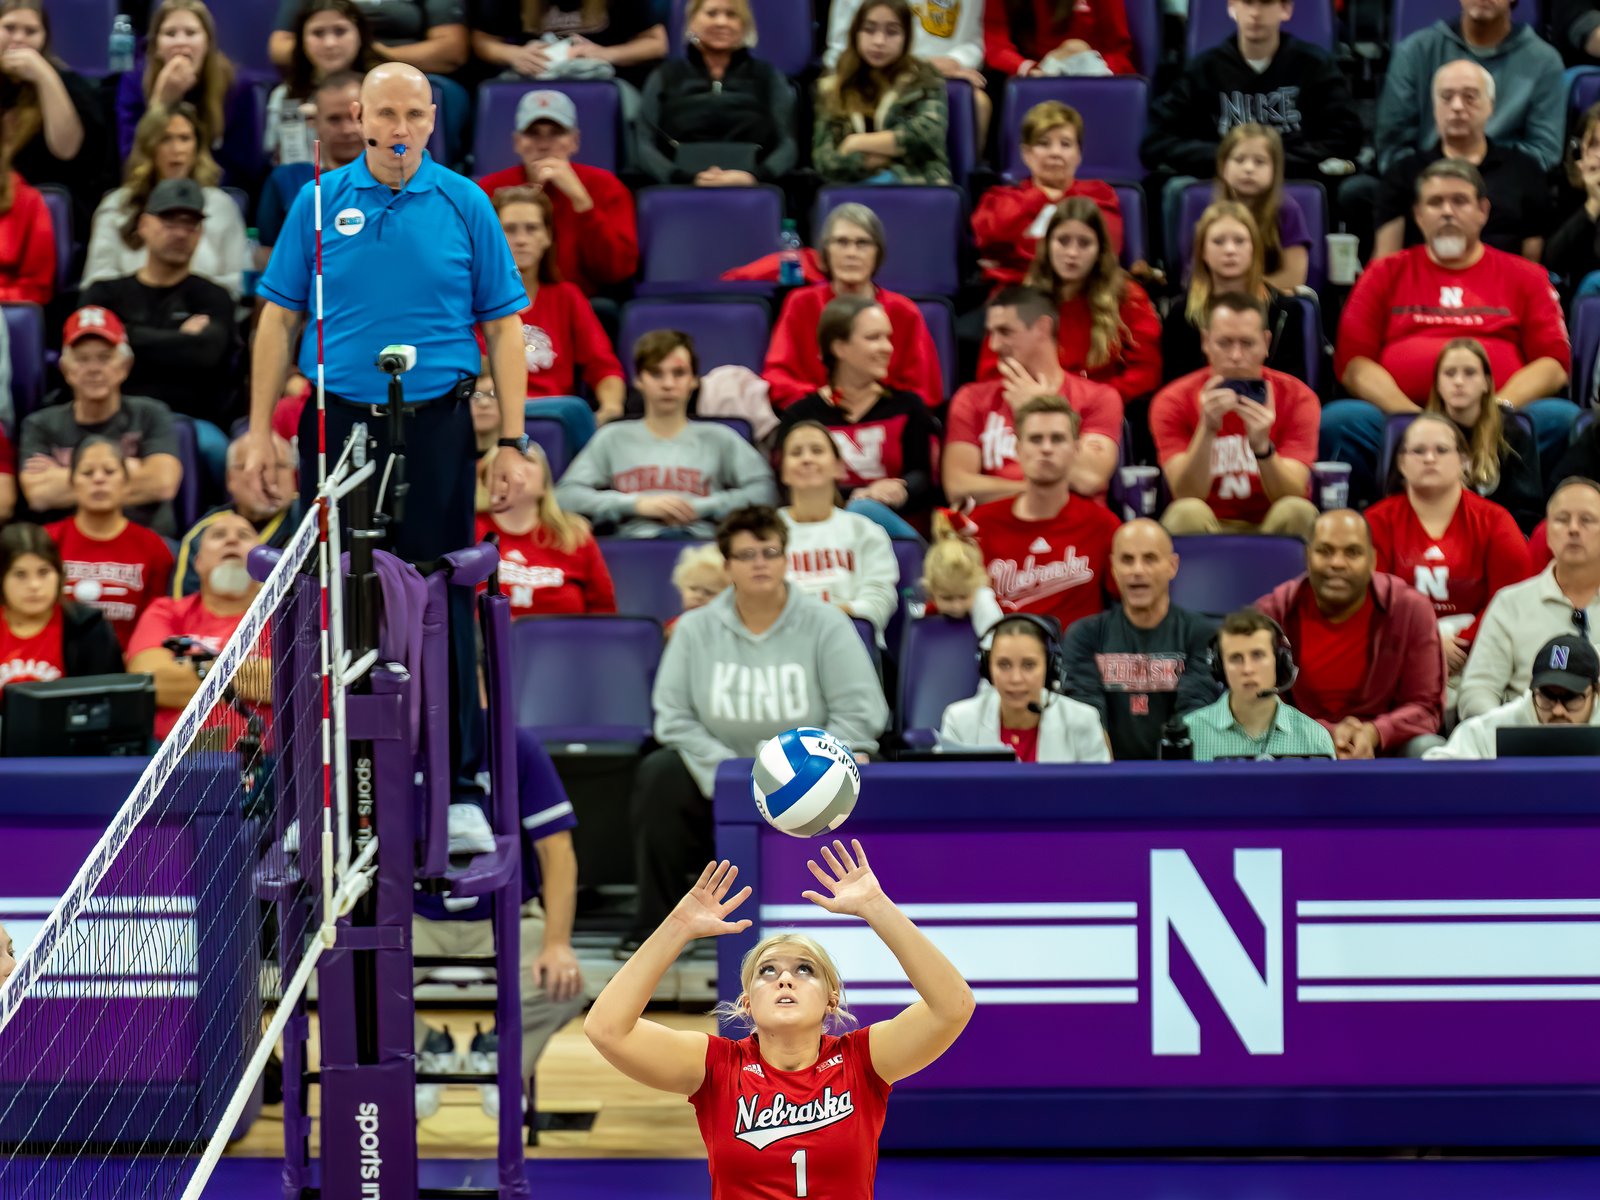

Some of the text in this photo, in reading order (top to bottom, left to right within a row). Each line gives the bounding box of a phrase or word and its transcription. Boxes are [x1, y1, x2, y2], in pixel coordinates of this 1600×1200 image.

[1440, 286, 1464, 308] N
[1219, 474, 1250, 498] N
[1414, 565, 1449, 601] N
[1550, 645, 1570, 670] N
[710, 661, 809, 722] KIND
[355, 758, 373, 816] sports
[1151, 848, 1284, 1055] N
[734, 1086, 854, 1135] Nebraska
[355, 1103, 382, 1179] sports
[791, 1149, 808, 1198] 1
